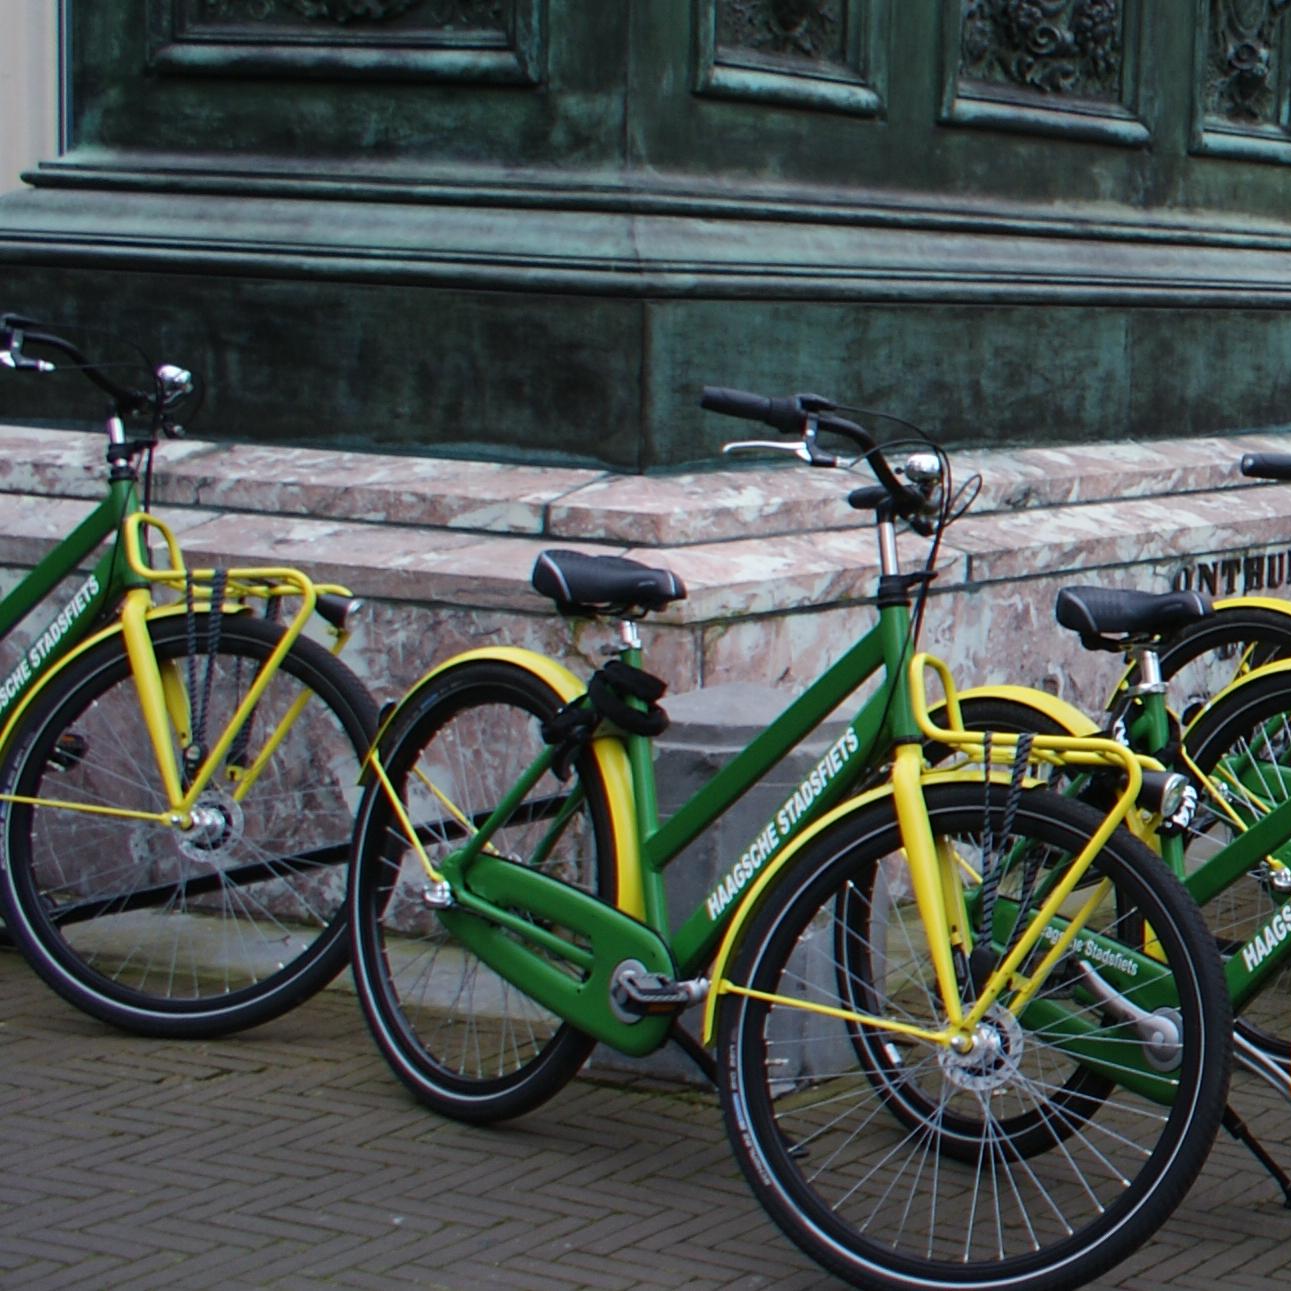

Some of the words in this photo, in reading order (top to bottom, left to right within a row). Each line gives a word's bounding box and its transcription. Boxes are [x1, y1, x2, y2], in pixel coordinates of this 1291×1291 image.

[29, 574, 99, 668] STADSFIETS
[706, 822, 780, 921] HAAGSCHE
[776, 727, 859, 835] STADSFIETS
